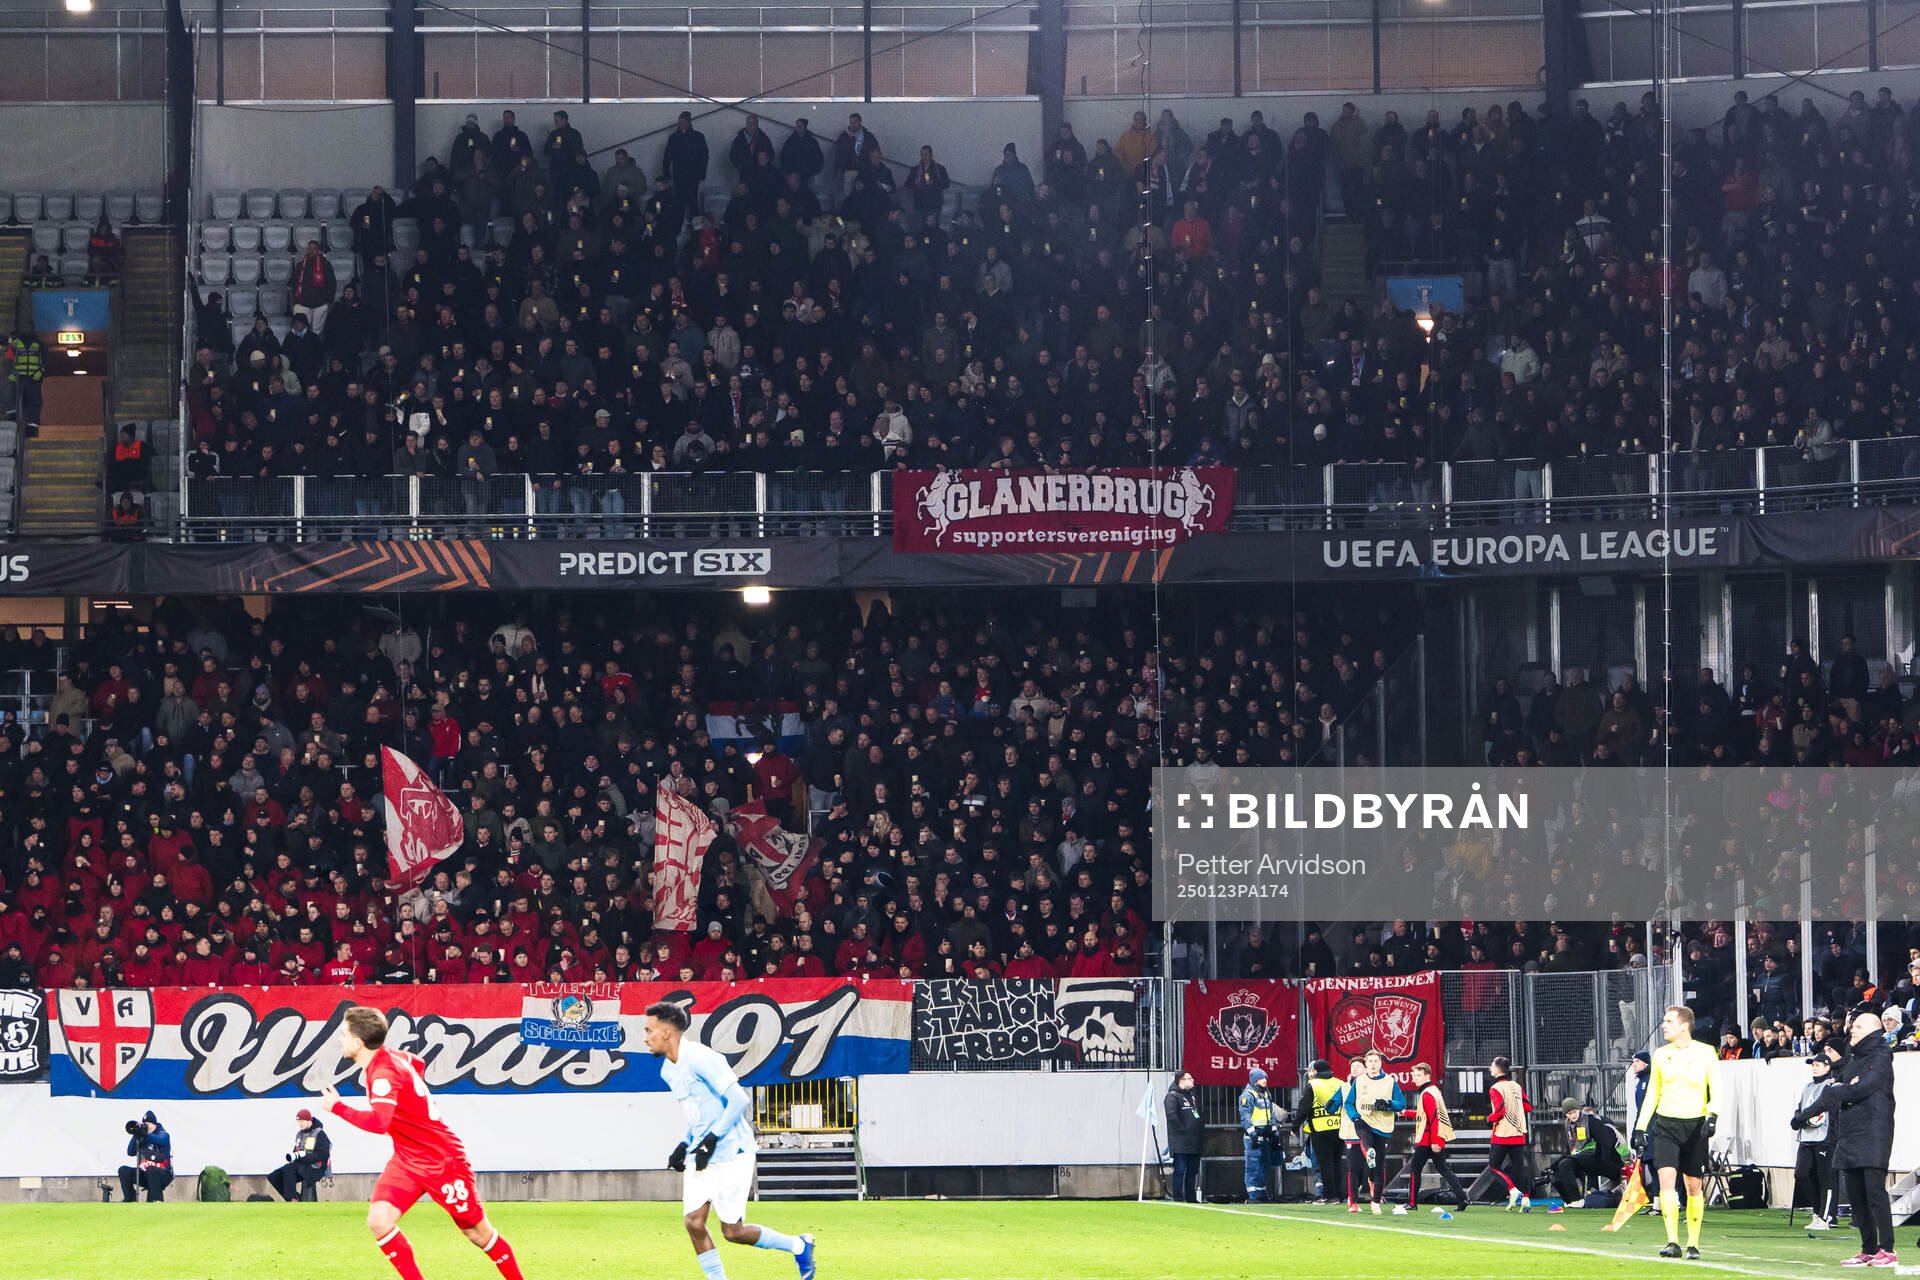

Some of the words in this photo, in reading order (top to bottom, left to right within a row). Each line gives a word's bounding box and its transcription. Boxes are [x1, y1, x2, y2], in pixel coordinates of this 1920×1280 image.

[946, 474, 1187, 521] GLANERBRUG
[953, 526, 1177, 547] supportersvereniging
[560, 551, 688, 575] PREDICT
[699, 552, 764, 573] SIX
[1323, 540, 1420, 568] UEFA
[1432, 533, 1570, 566] EUROPA
[75, 997, 91, 1016] V
[117, 996, 134, 1018] A
[916, 991, 1057, 1038] STADION
[524, 1020, 620, 1043] SCHALKE
[918, 1021, 1062, 1061] VERBOD
[80, 1047, 95, 1066] K
[120, 1046, 136, 1064] P
[441, 1179, 469, 1205] 28
